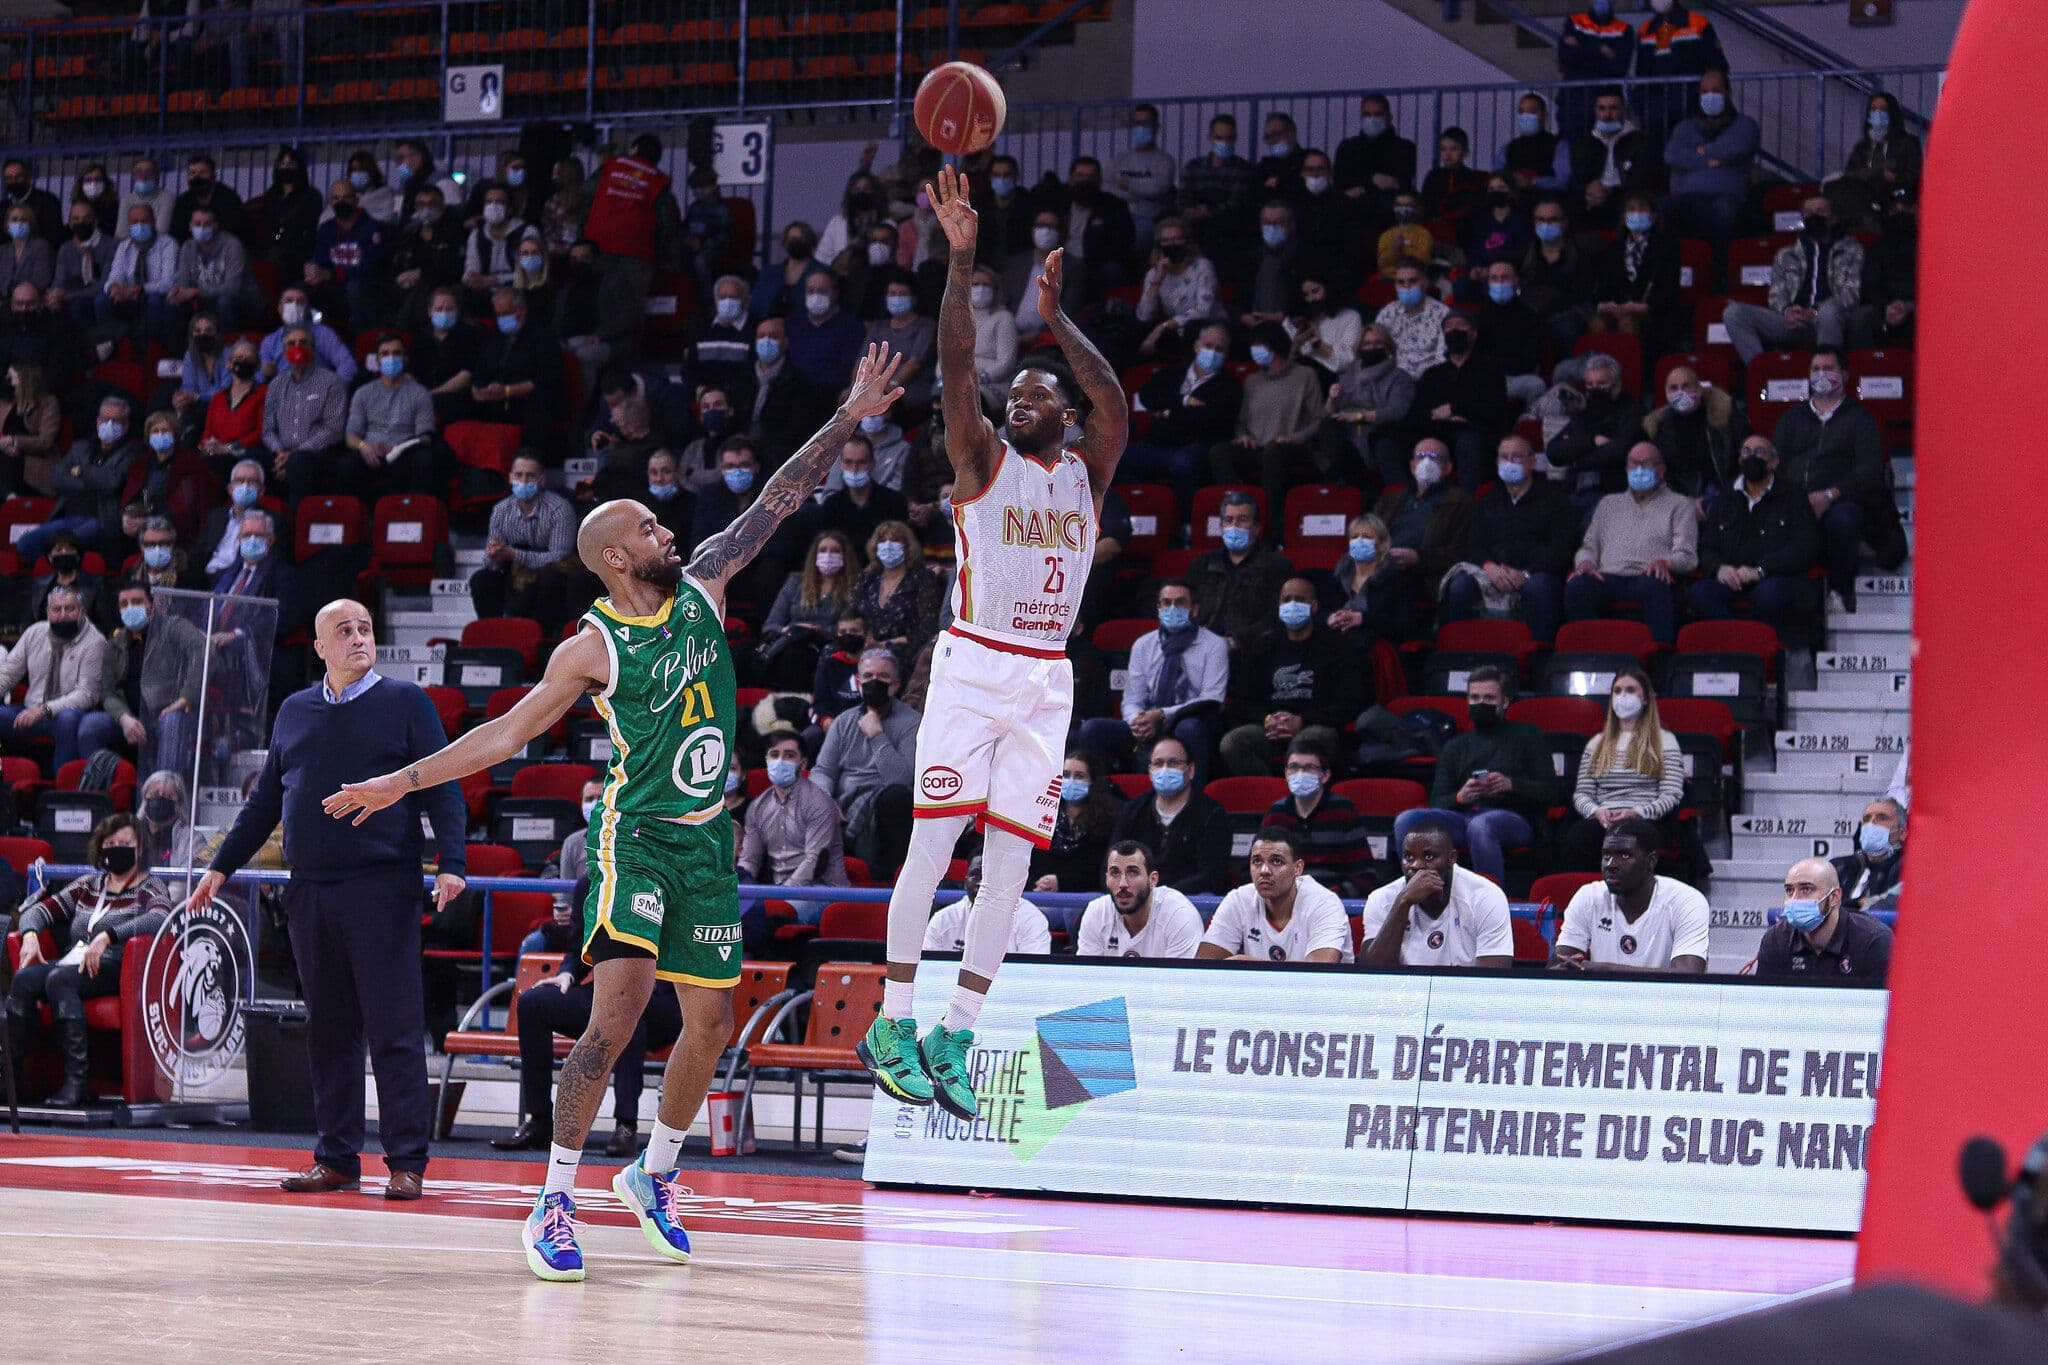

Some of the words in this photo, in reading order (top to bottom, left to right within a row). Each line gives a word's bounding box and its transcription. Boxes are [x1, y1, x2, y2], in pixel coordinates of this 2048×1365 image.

[450, 73, 466, 94] G
[741, 131, 763, 178] 3
[1003, 505, 1088, 552] NANCY
[1841, 656, 1857, 670] 262
[1861, 657, 1868, 670] A
[418, 667, 428, 681] F
[650, 636, 718, 713] Blois
[1894, 675, 1906, 692] F
[680, 681, 715, 728] 21
[1800, 736, 1818, 750] 239
[1821, 736, 1829, 749] A
[1831, 736, 1850, 750] 250
[1897, 737, 1904, 750] A
[1855, 755, 1868, 772] E
[923, 776, 959, 789] cora
[1755, 819, 1773, 834] 238
[1777, 819, 1785, 833] A
[1787, 819, 1806, 833] 227
[1834, 820, 1852, 834] 291
[1814, 840, 1830, 857] D
[1711, 911, 1729, 926] 215
[1732, 911, 1741, 925] A
[1743, 911, 1763, 926] 226
[1173, 1028, 1217, 1073] LE
[1226, 1029, 1379, 1080] CONSEIL
[1392, 1023, 1724, 1093] DÉPARTEMENTAL
[1738, 1048, 1790, 1096] DE
[1345, 1103, 1586, 1158] PARTENAIRE
[1595, 1114, 1651, 1161] DU
[1662, 1115, 1764, 1167] SLUC
